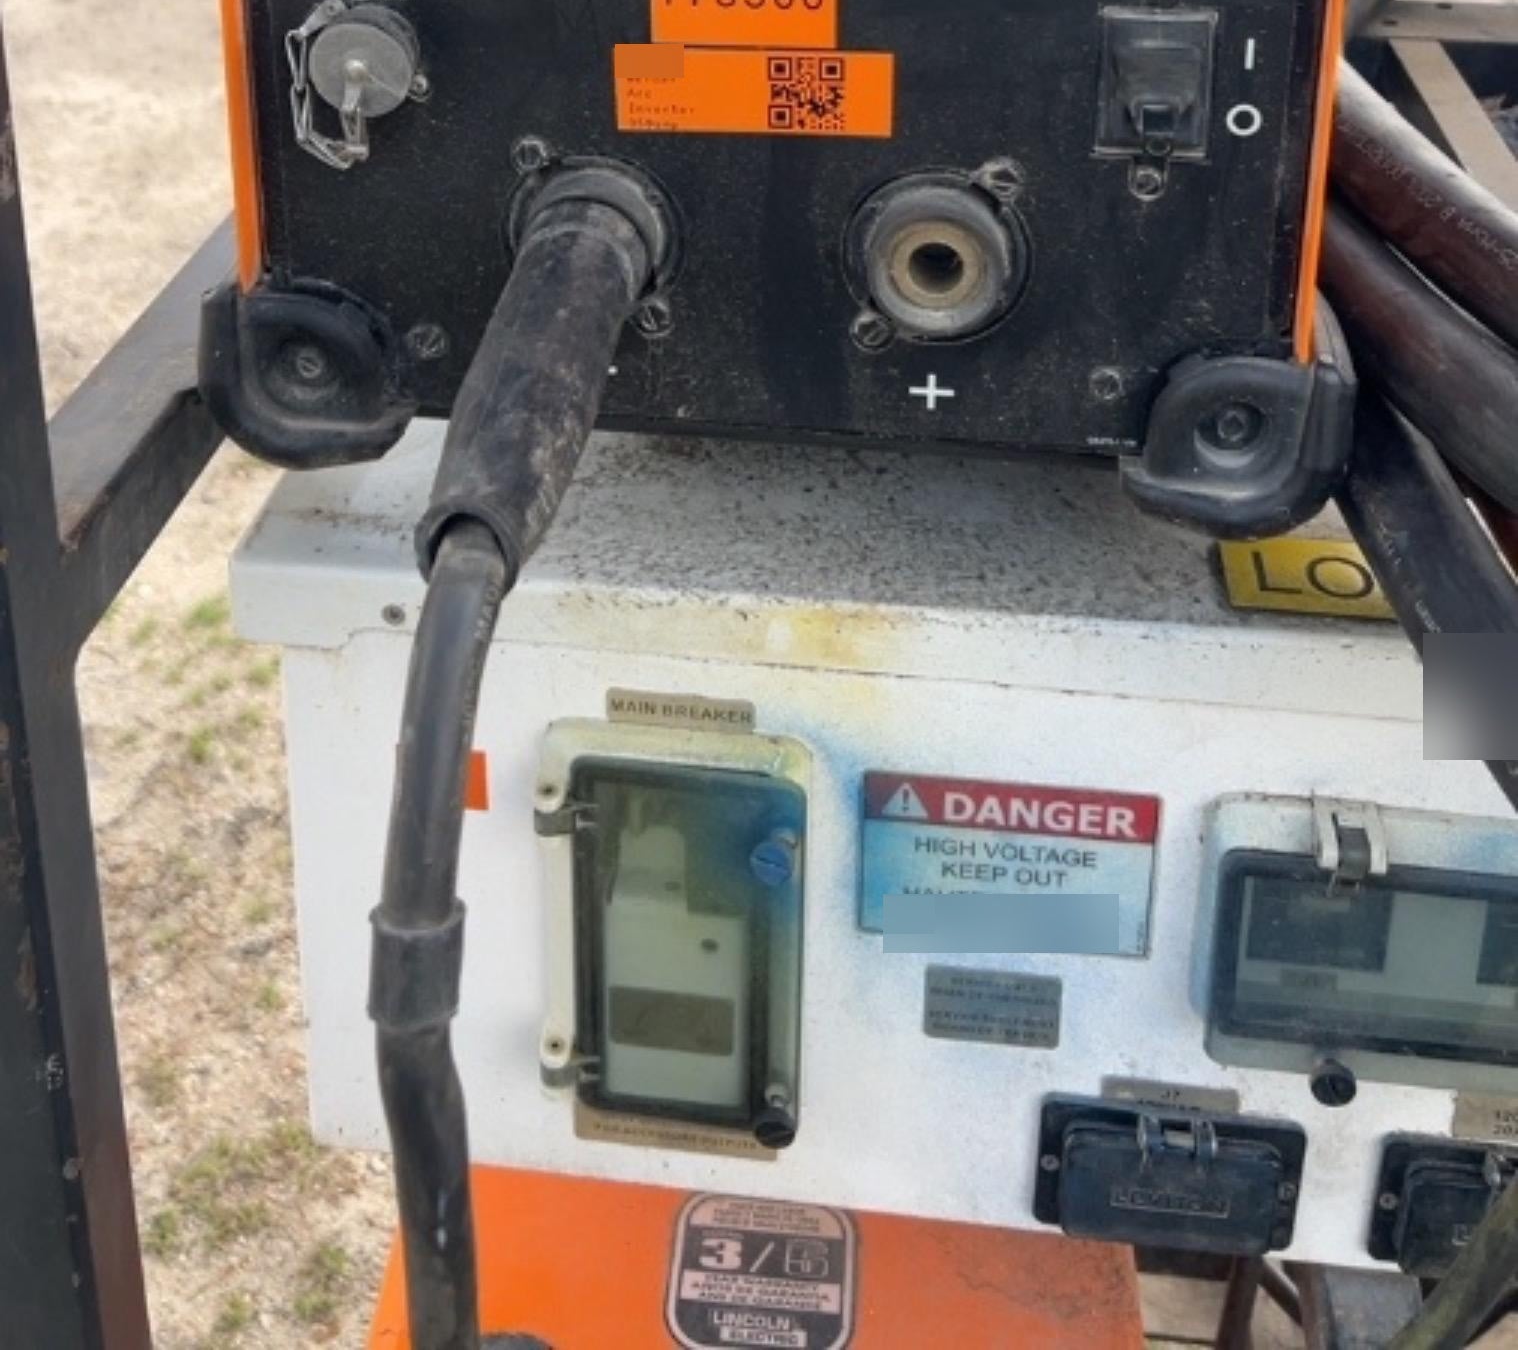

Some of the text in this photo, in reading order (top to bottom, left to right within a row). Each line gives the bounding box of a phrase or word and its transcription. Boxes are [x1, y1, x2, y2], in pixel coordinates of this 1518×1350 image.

[611, 697, 753, 724] MAIN BREAKER
[943, 791, 1138, 838] DANGER
[914, 836, 1098, 869] HIGH VOLTAGE
[941, 862, 1069, 888] KEEP OUT
[713, 1310, 790, 1331] LINCOLN
